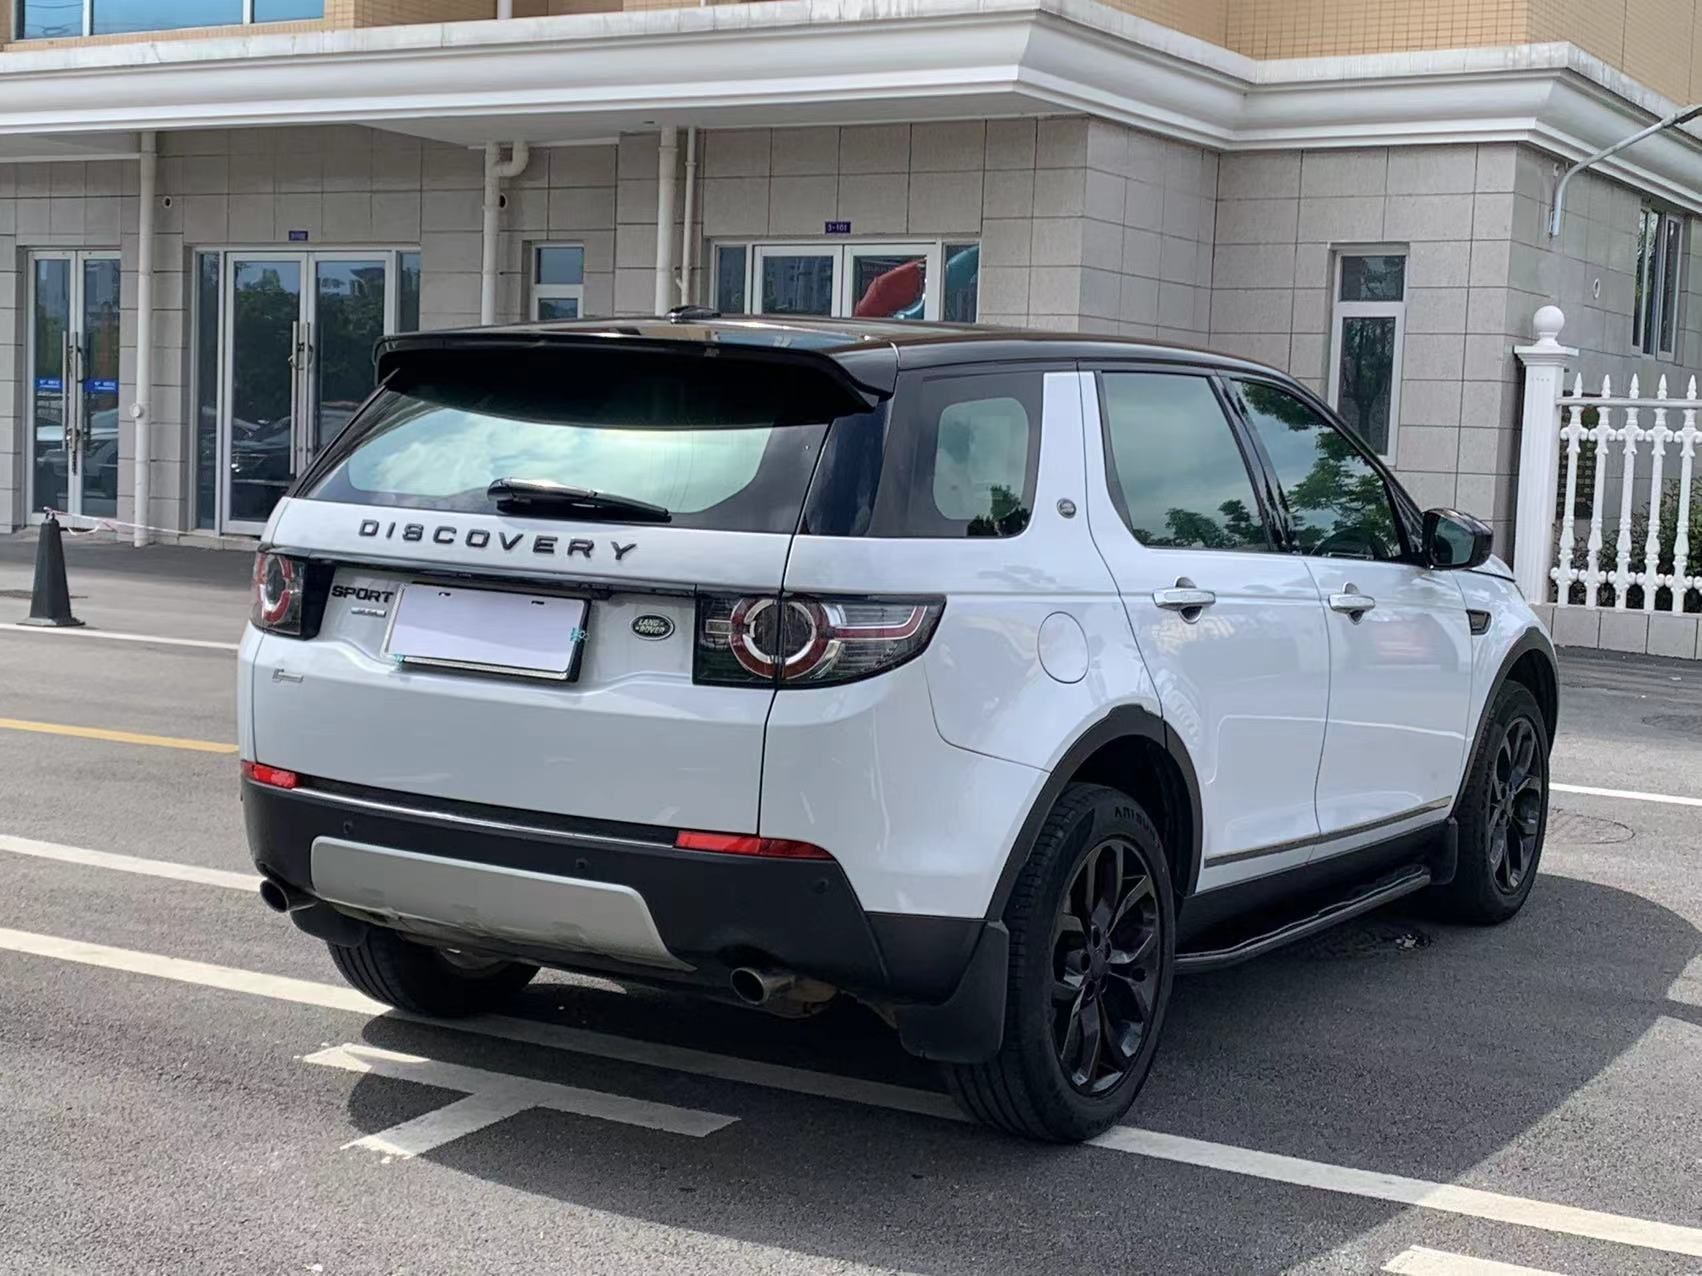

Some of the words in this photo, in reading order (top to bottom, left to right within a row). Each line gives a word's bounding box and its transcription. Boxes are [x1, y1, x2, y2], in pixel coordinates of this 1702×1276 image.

[358, 519, 638, 561] DISCOVERY
[331, 584, 395, 603] SPORT
[639, 626, 665, 634] ROVER
